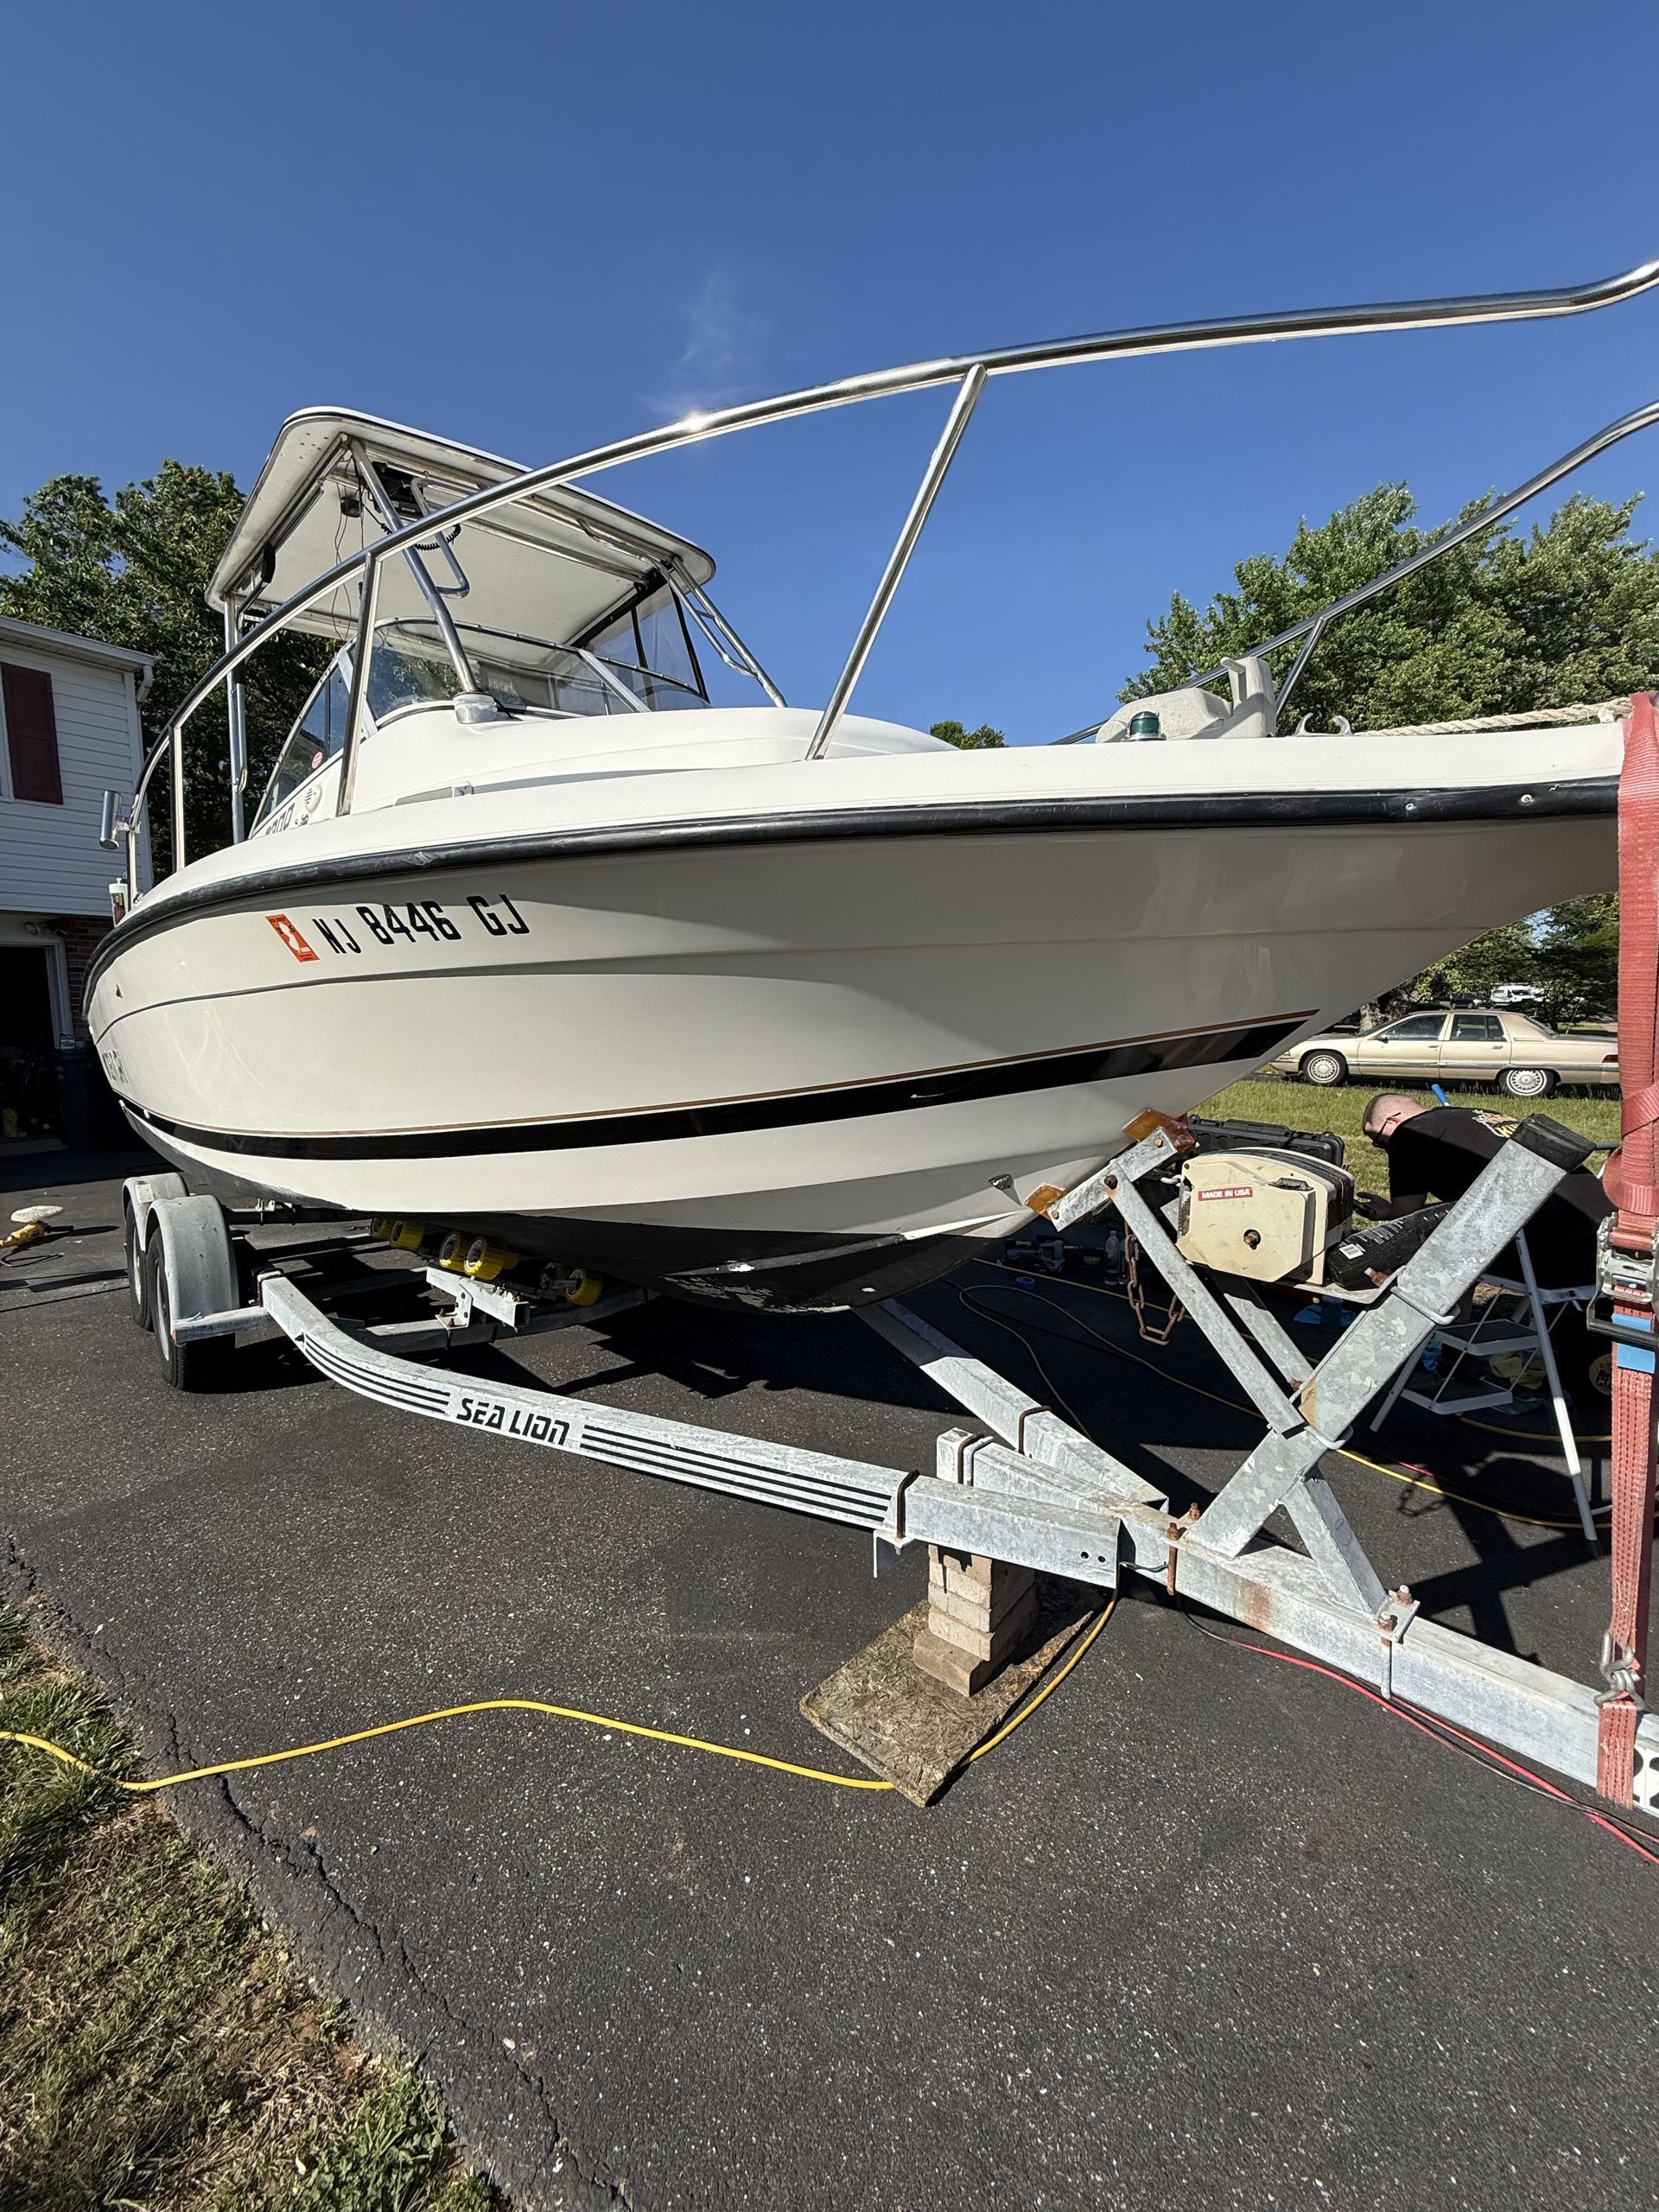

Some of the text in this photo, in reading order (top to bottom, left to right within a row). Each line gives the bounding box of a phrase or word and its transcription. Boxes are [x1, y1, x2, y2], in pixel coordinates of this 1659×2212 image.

[312, 918, 362, 954] NJ
[355, 900, 462, 945] 8446
[466, 893, 531, 937] GJ
[1202, 1191, 1224, 1199] MADE
[456, 1397, 570, 1446] SEA LION
